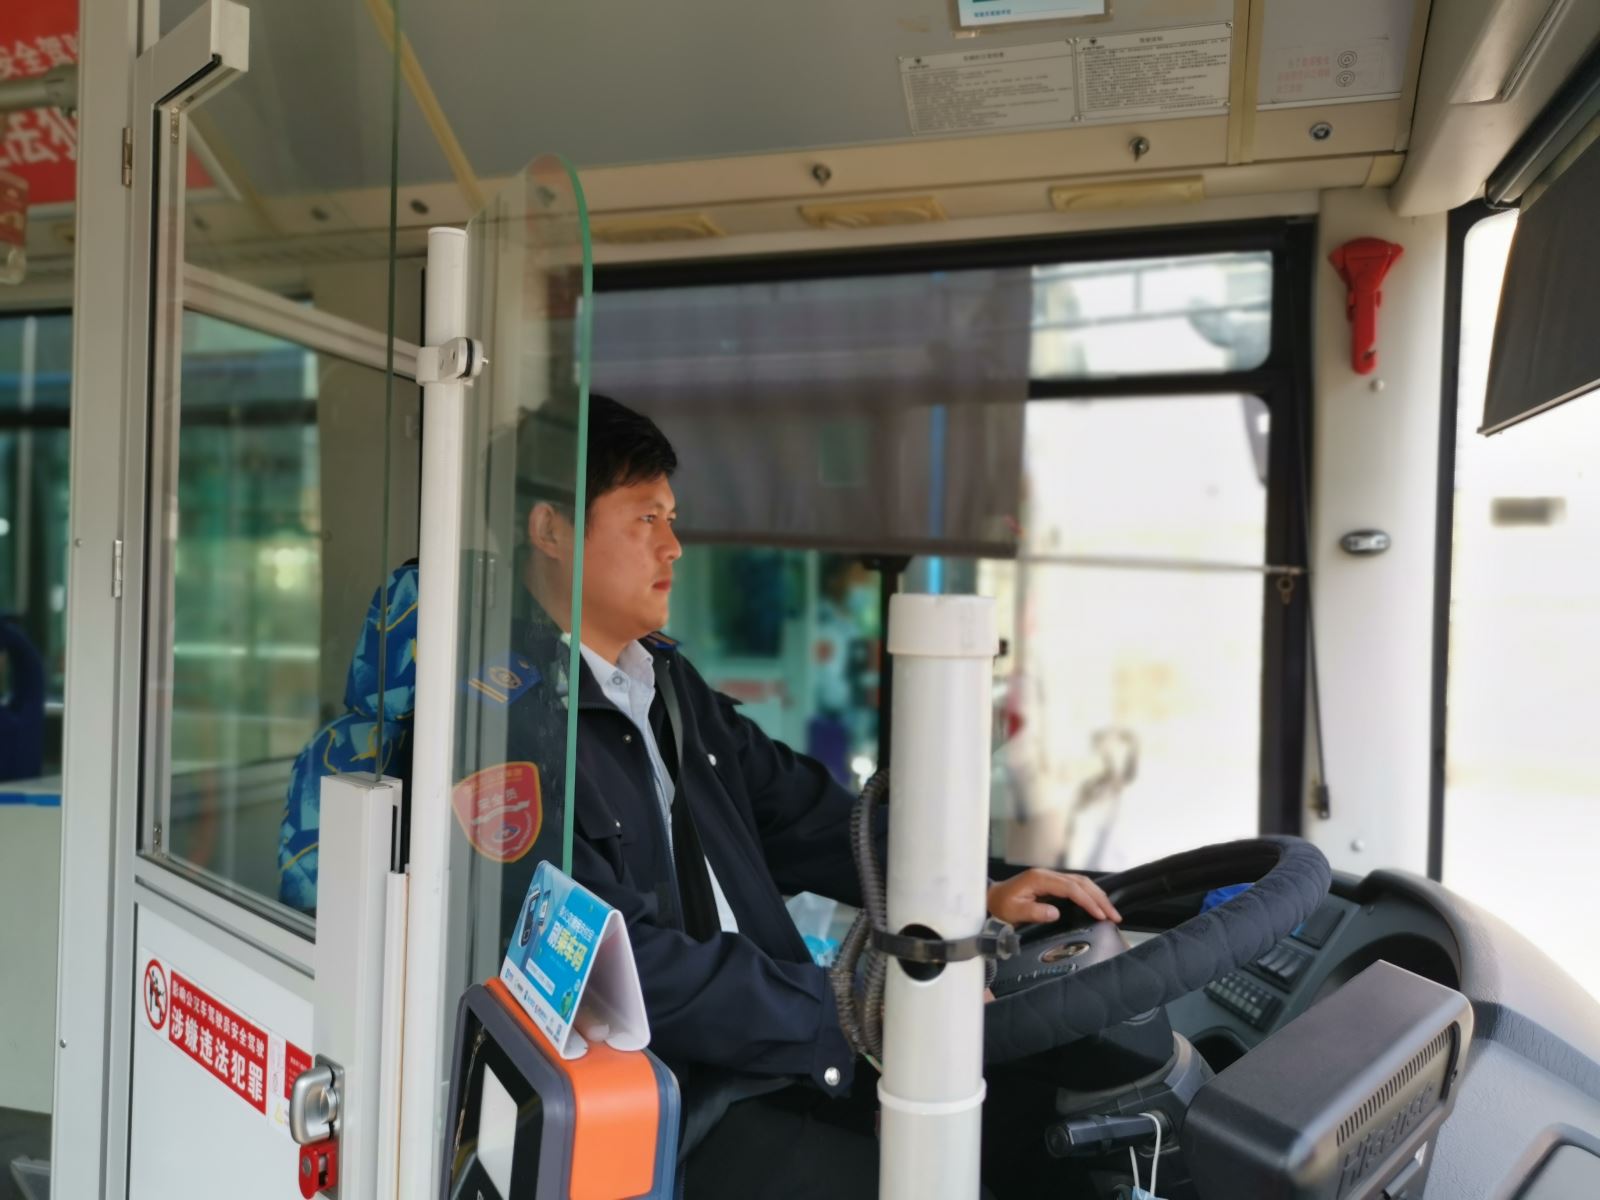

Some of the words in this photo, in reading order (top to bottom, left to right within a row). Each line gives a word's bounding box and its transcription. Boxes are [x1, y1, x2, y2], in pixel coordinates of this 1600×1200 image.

[171, 1005, 263, 1102] 涉嫌违法犯罪
[172, 980, 265, 1059] 影响公交车驾驶员安全驾驶
